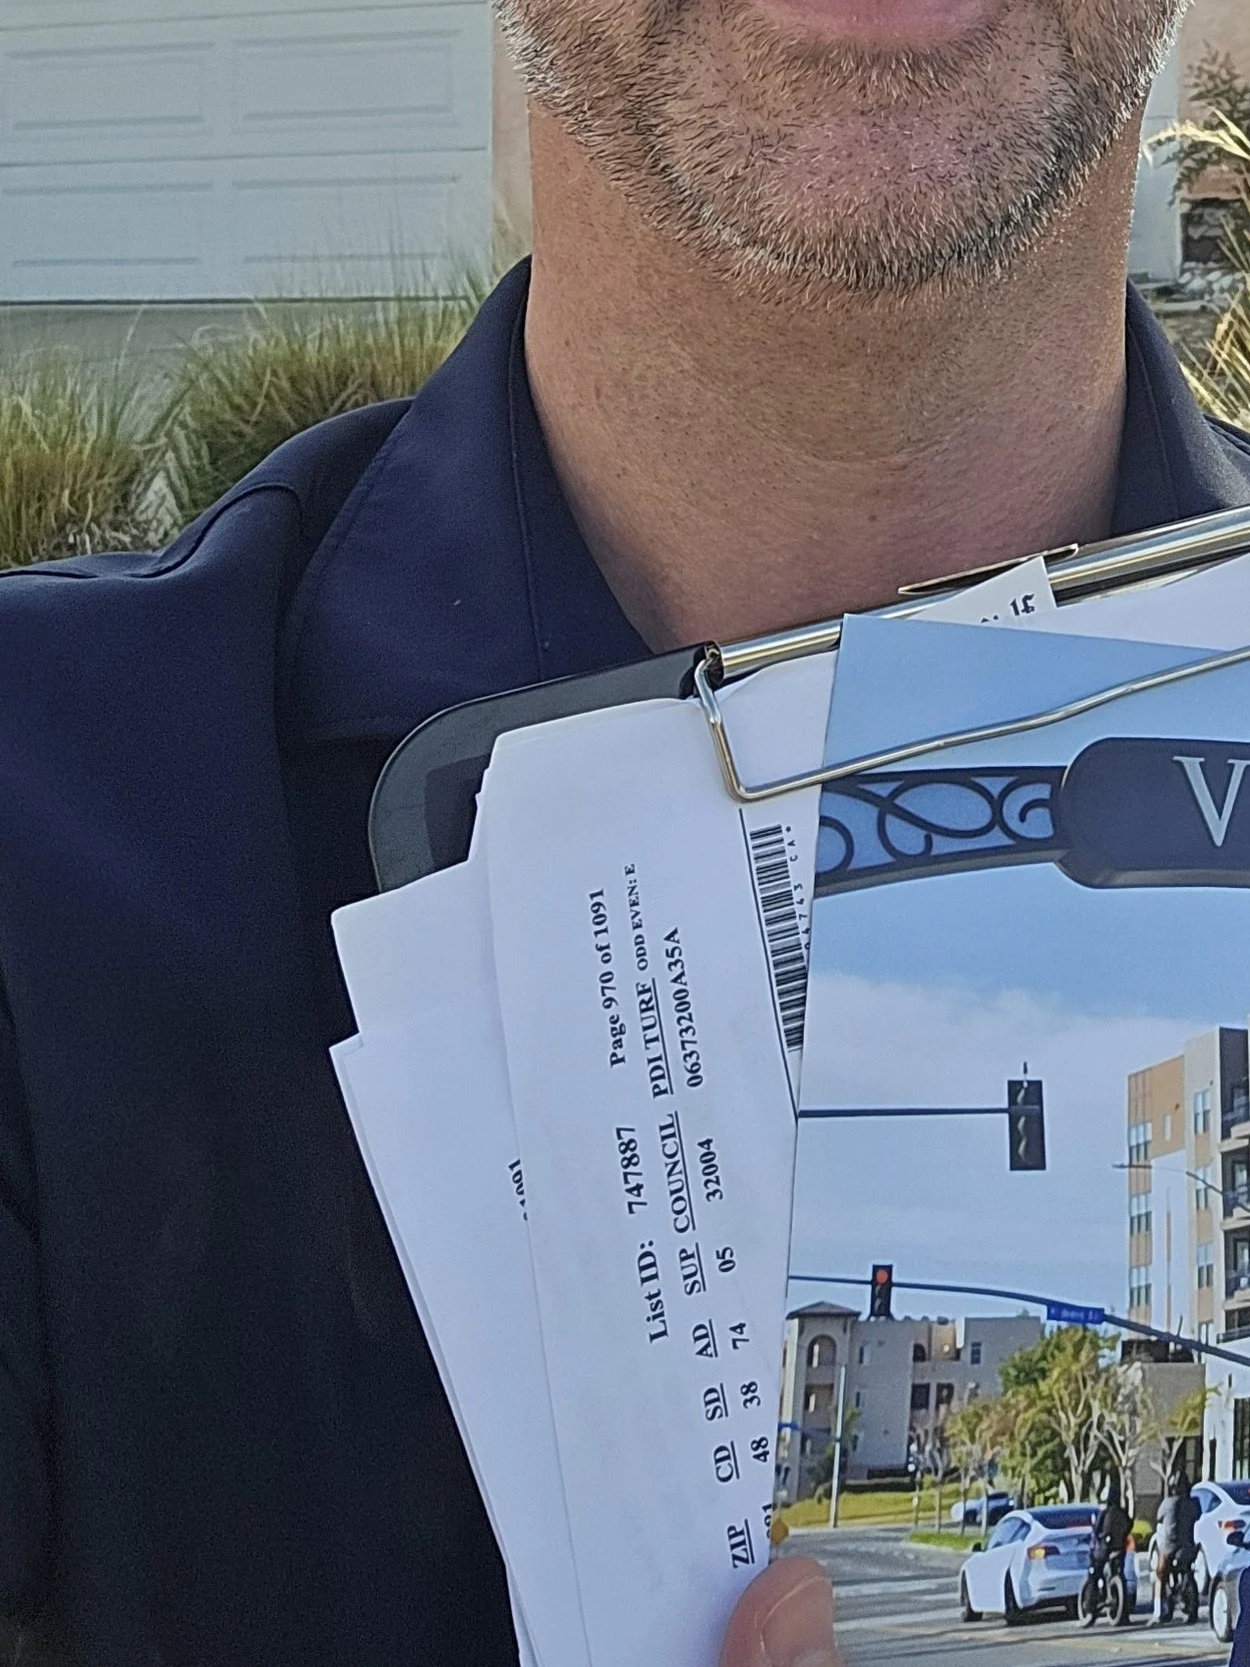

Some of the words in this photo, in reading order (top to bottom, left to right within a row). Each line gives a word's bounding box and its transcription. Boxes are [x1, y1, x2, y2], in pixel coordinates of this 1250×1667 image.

[624, 863, 636, 876] E
[588, 888, 610, 938] 1091
[626, 879, 643, 931] EVEN:
[594, 942, 613, 965] of
[634, 934, 649, 971] ODD
[599, 970, 619, 1011] 970
[663, 926, 704, 1088] 06373200A35A
[635, 982, 660, 1051] TURF
[608, 1013, 628, 1068] Page
[645, 1053, 669, 1100] PDI
[615, 1126, 648, 1216] 747887
[658, 1112, 691, 1235] COUNCIL
[697, 1137, 724, 1203] 32004
[637, 1239, 660, 1287] ID:
[678, 1247, 702, 1297] SUP
[715, 1245, 737, 1274] 05
[644, 1287, 670, 1344] List
[729, 1321, 750, 1351] 74
[692, 1322, 714, 1359] AD
[703, 1387, 724, 1422] SD
[740, 1380, 761, 1410] 38
[713, 1445, 734, 1483] CD
[750, 1435, 770, 1464] 48
[726, 1524, 750, 1570] ZIP
